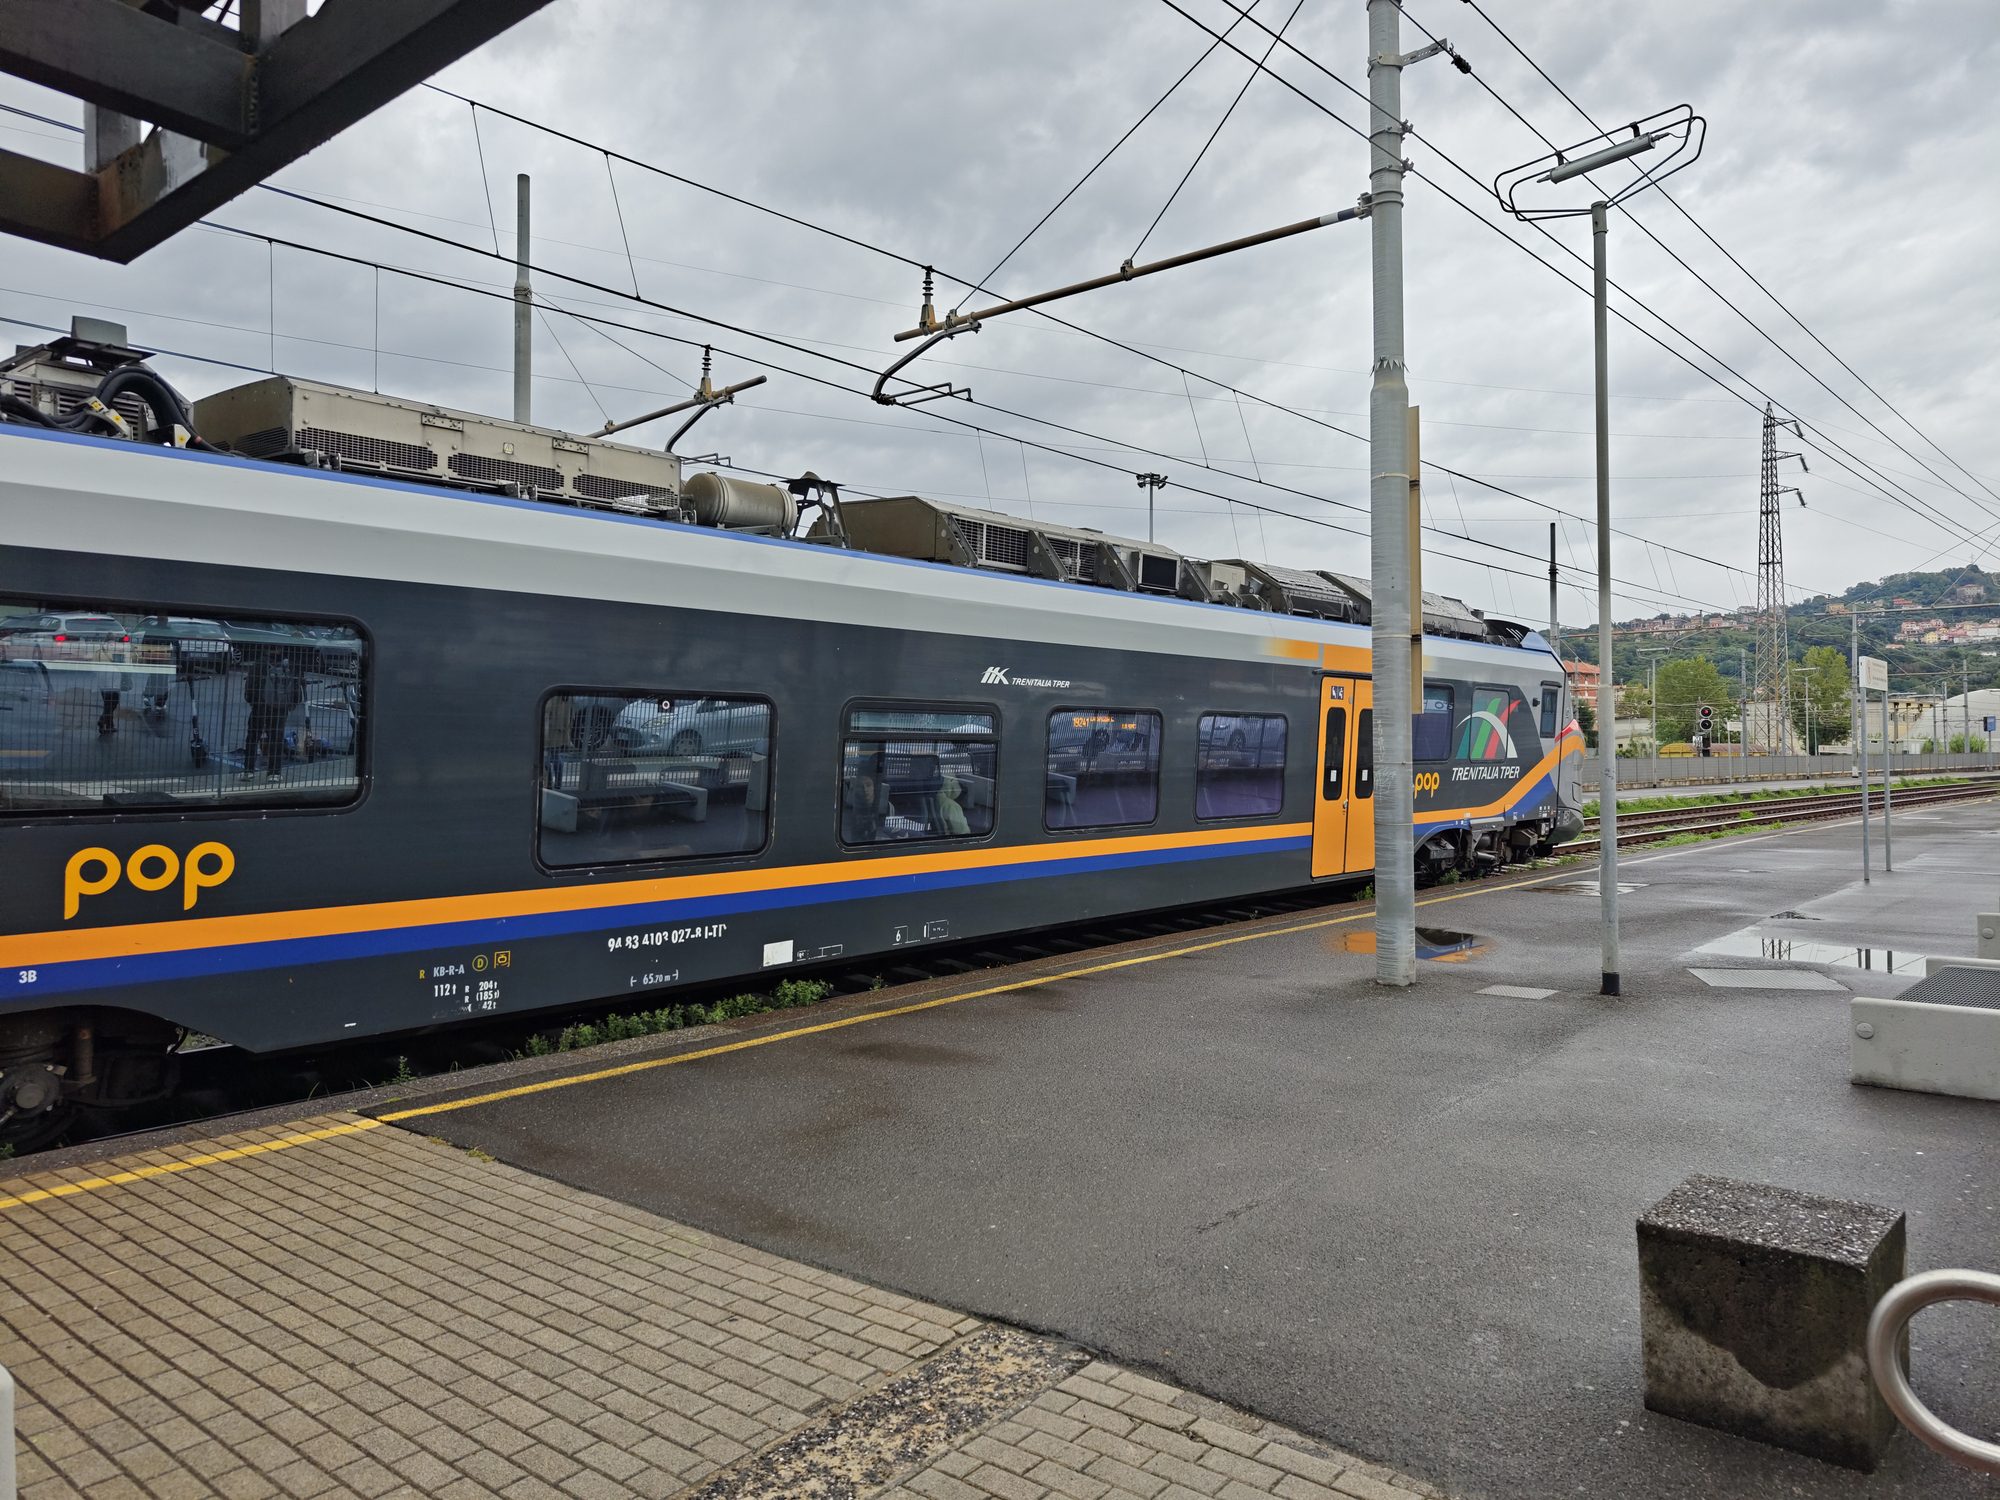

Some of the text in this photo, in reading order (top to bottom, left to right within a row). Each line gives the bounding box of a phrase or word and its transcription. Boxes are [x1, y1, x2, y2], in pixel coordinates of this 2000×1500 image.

[1012, 677, 1071, 689] TRENITALIA TPER
[1451, 766, 1520, 781] TRENITALIA TPER
[1414, 772, 1440, 800] pop
[64, 841, 236, 920] pop
[18, 969, 38, 984] 3B
[433, 964, 465, 977] KB-R-A
